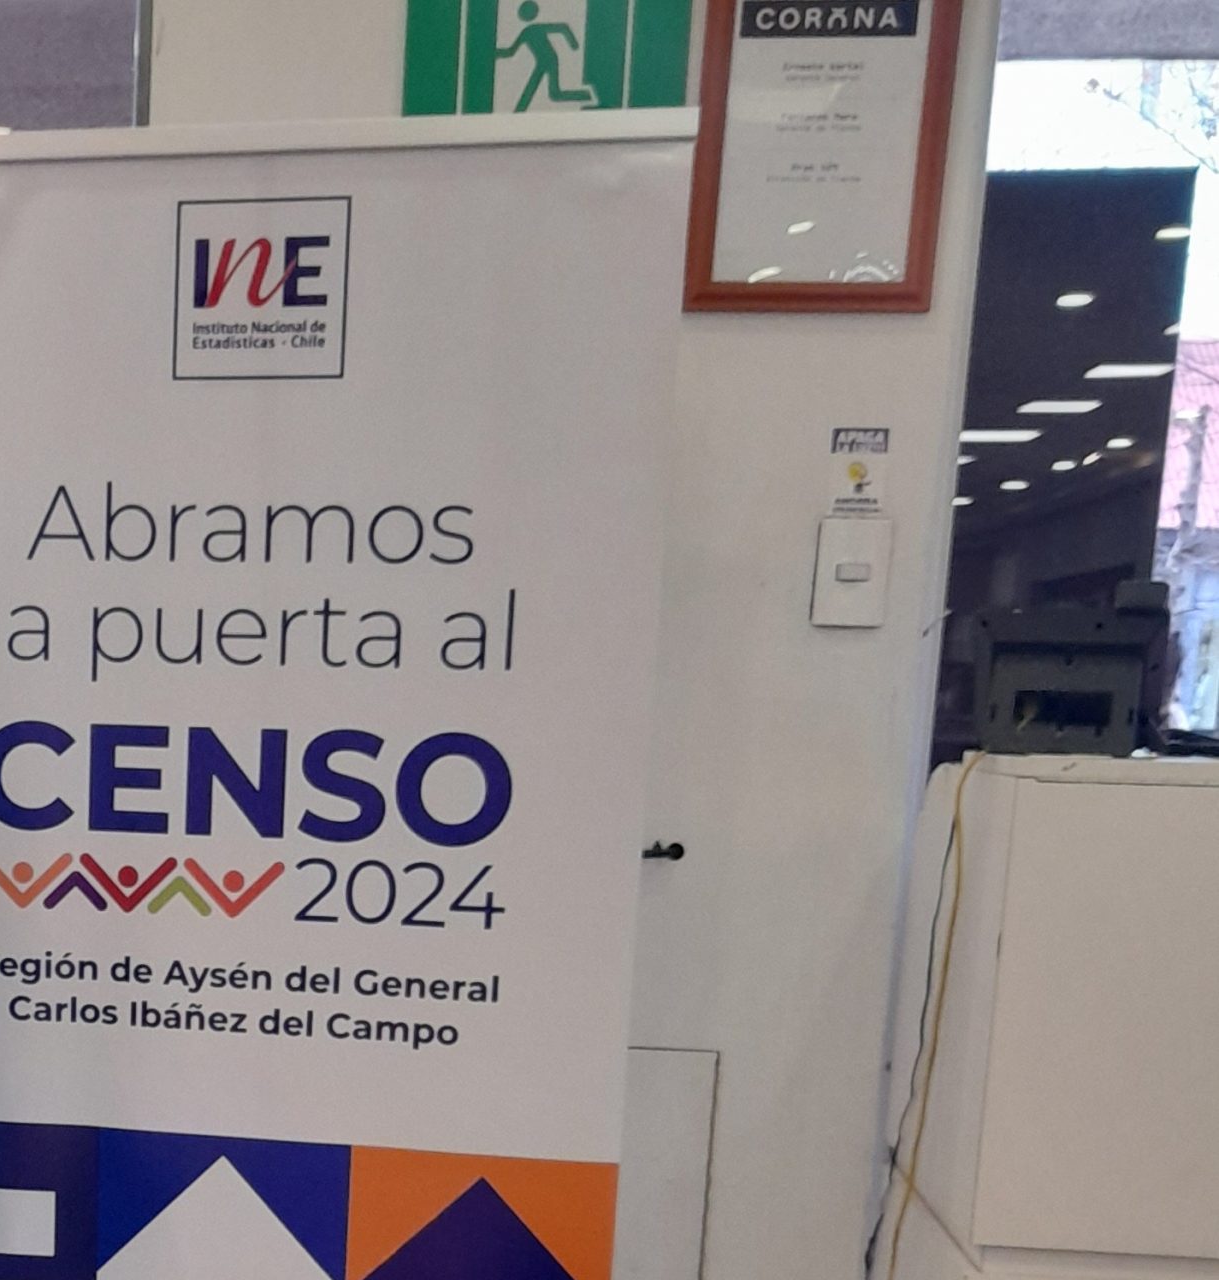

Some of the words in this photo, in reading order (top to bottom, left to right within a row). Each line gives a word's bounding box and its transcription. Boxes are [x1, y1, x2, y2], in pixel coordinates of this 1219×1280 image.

[756, 7, 899, 30] CORONA
[192, 322, 247, 335] Instituto
[252, 320, 307, 334] Nacional
[310, 320, 326, 333] de
[291, 335, 326, 348] Chile
[27, 481, 474, 564] Abramos
[91, 598, 401, 682] puerta
[440, 588, 516, 671] al
[294, 857, 505, 930] 2024
[110, 956, 153, 983] de
[164, 960, 272, 993] Aysén
[285, 966, 340, 995] del
[354, 969, 499, 1003] General
[8, 995, 118, 1024] Carlos
[130, 1001, 247, 1033] Ibáñez
[259, 1009, 313, 1037] del
[326, 1013, 459, 1050] Campo
